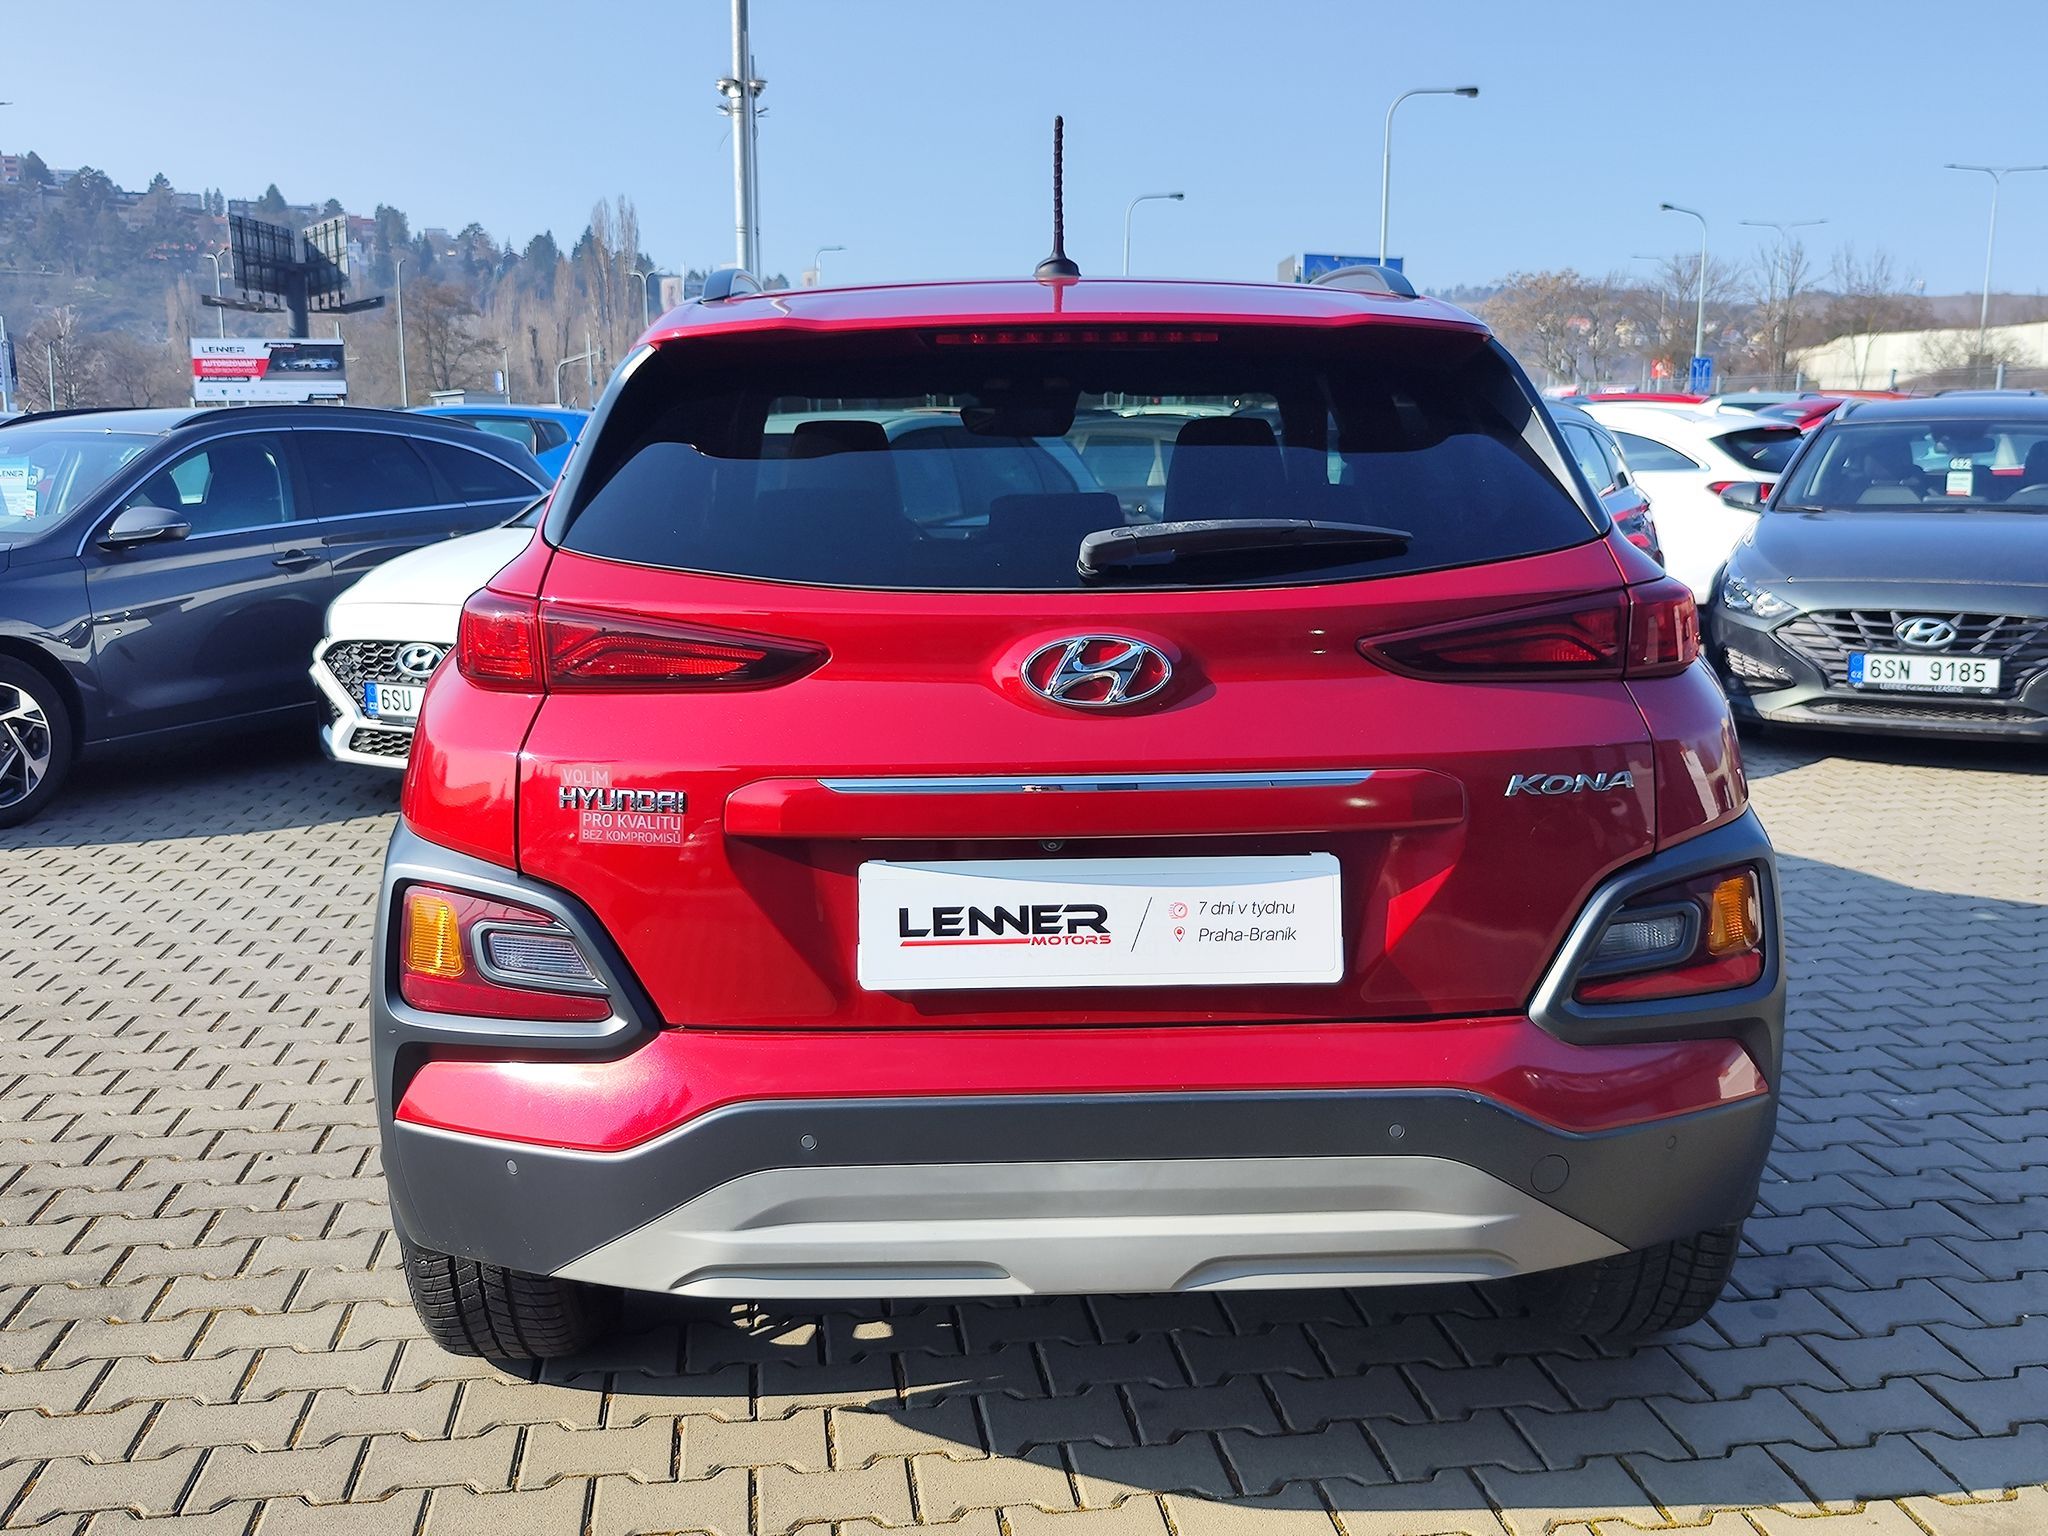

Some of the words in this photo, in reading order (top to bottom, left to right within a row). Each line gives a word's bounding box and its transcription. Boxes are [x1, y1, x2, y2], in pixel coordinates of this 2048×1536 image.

[201, 346, 245, 354] LENNER
[1870, 659, 1911, 680] 6SN
[1930, 661, 1986, 683] 9185
[381, 689, 412, 711] 6SU
[563, 767, 609, 785] VOLÍM
[1504, 770, 1635, 797] KONA
[559, 786, 687, 813] HYUNDAI
[582, 813, 613, 828] PRO
[618, 814, 681, 830] KVALITU
[582, 830, 602, 840] BEZ
[606, 831, 681, 844] KOMPROMISŮ
[1199, 901, 1208, 915] 7
[1211, 901, 1236, 915] dní
[1238, 903, 1248, 914] v
[1252, 901, 1296, 918] týdnu
[899, 904, 1112, 937] LENNER
[1031, 935, 1112, 946] MOTORS
[1198, 927, 1297, 942] Praha-Braník
